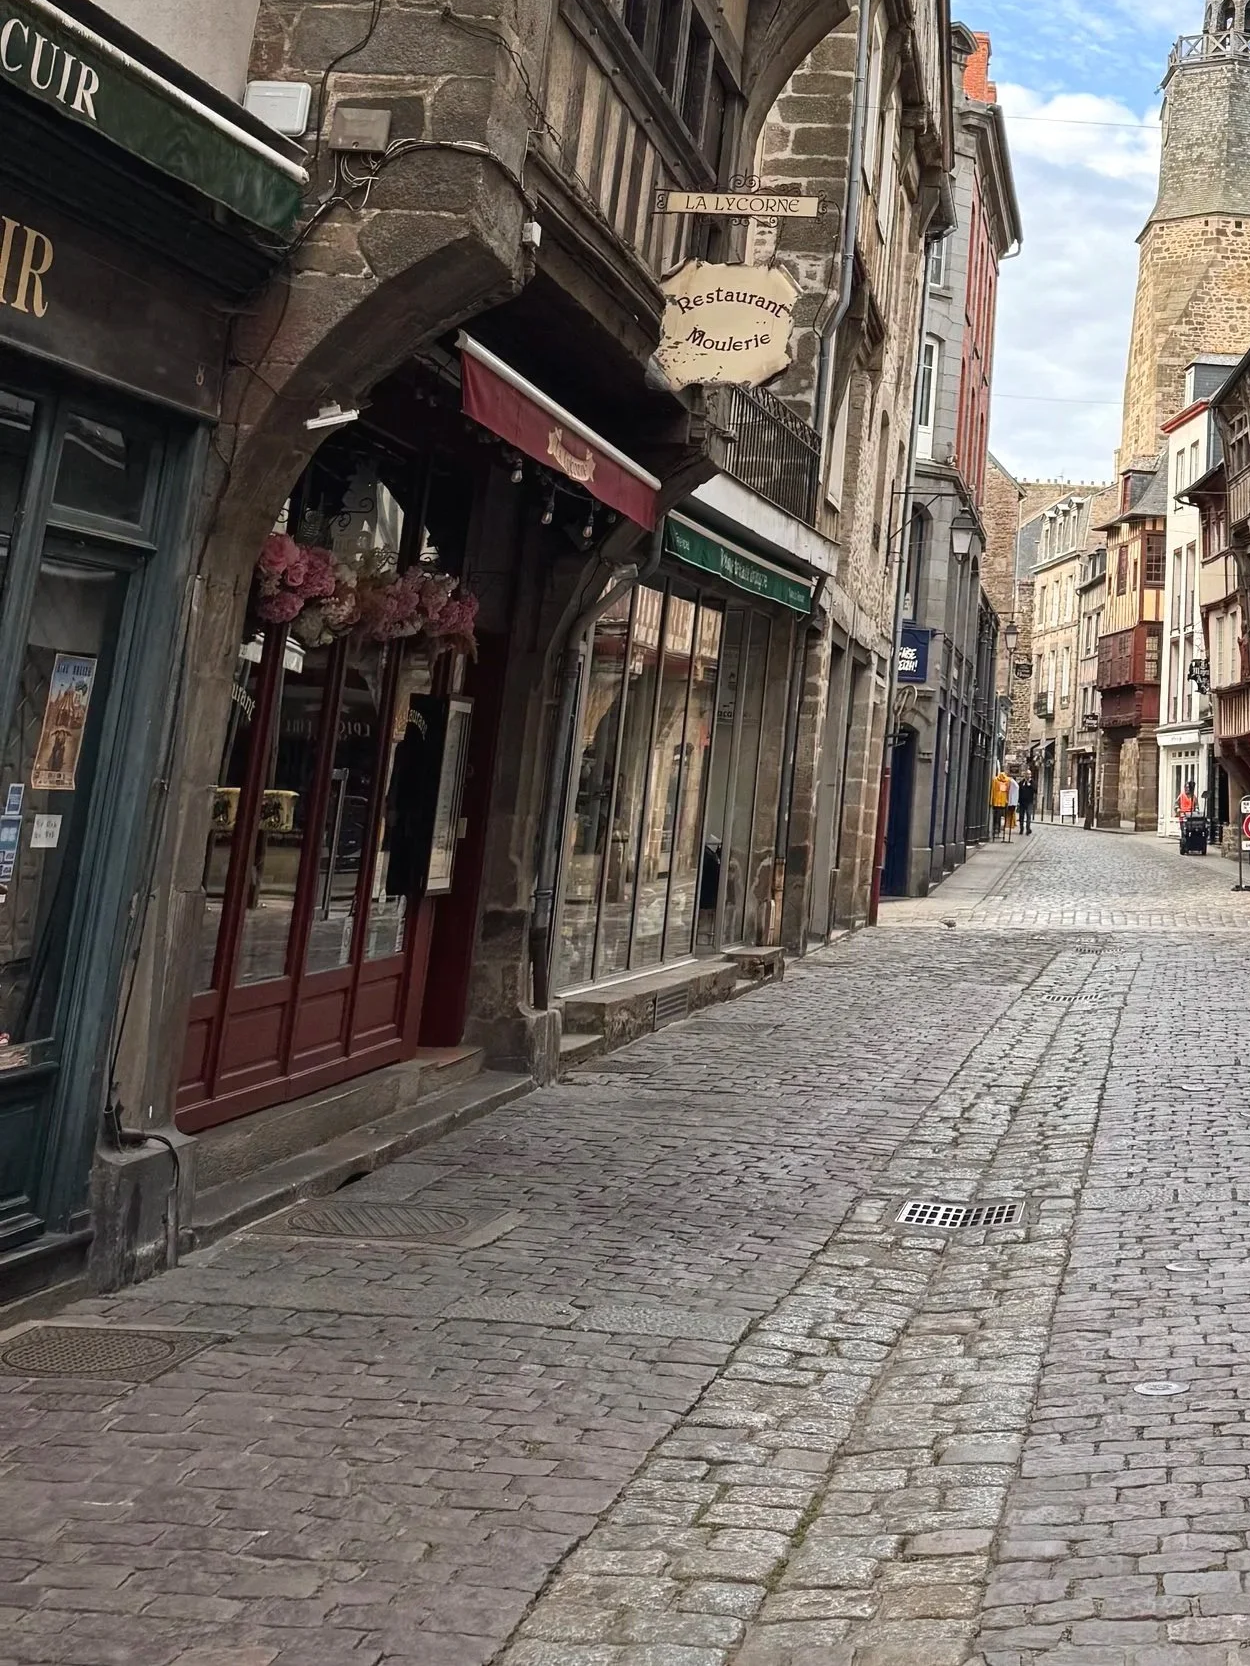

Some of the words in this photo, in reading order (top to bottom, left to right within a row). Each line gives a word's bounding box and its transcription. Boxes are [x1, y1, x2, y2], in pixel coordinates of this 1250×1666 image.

[1, 18, 99, 121] CUIR
[685, 195, 707, 211] LA
[715, 196, 800, 213] LYCORNE
[676, 286, 786, 318] Restaurant
[685, 326, 771, 352] Moulerie
